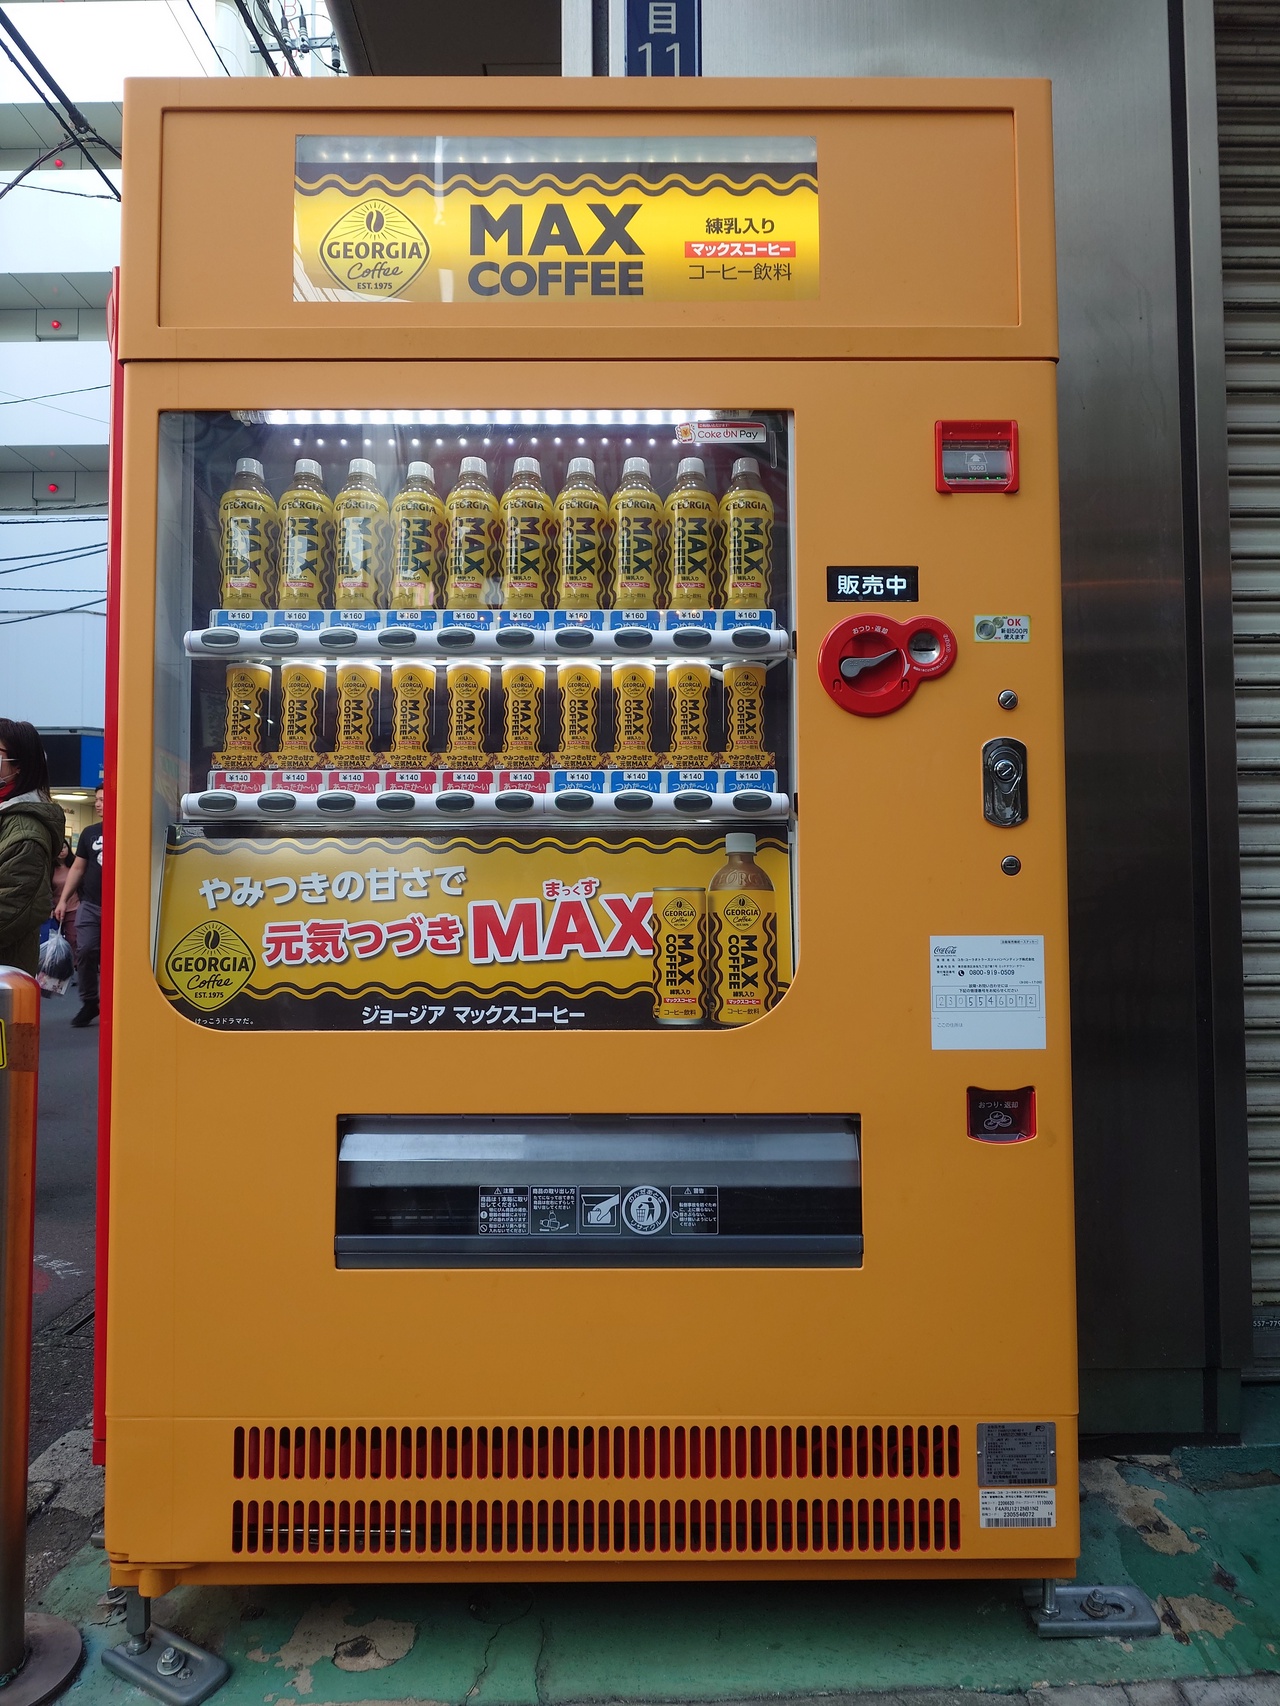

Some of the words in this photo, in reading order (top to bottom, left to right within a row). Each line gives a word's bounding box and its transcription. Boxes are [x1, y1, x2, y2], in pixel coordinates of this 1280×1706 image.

[649, 2, 677, 34] 目
[638, 42, 680, 76] 11
[469, 204, 645, 256] MAX
[705, 217, 775, 235] 練乳入り
[327, 241, 422, 259] GEORGIA
[690, 242, 791, 257] マックスコーヒー
[347, 261, 403, 281] Coffee
[468, 261, 644, 296] COFFEE
[688, 264, 792, 281] コーヒー飲料
[697, 430, 721, 439] Coke
[740, 430, 759, 440] Pay
[412, 519, 431, 577] MAX
[465, 518, 485, 576] MAX
[519, 517, 540, 575] MAX
[576, 517, 596, 575] MAX
[632, 517, 653, 575] MAX
[688, 517, 707, 575] MAX
[744, 517, 763, 575] MAX
[838, 575, 907, 595] 販売中
[1007, 618, 1021, 626] OK
[231, 700, 239, 736] COFFEE
[287, 700, 295, 736] COFFEE
[295, 700, 307, 735] MAX
[343, 700, 351, 736] COFFEE
[351, 700, 363, 735] MAX
[408, 700, 419, 735] MAX
[455, 700, 463, 736] COFFEE
[464, 700, 476, 735] MAX
[520, 700, 531, 735] MAX
[577, 700, 588, 735] MAX
[624, 700, 632, 736] COFFEE
[633, 700, 644, 735] MAX
[689, 700, 700, 735] MAX
[745, 699, 756, 734] MAX
[199, 866, 467, 910] やみつきの甘さで
[543, 877, 599, 899] まっくす
[263, 914, 463, 965] 元気つづき
[469, 894, 653, 962] MAX
[172, 956, 249, 972] GEORGIA
[665, 934, 677, 986] COFFEE
[677, 934, 694, 986] MAX
[728, 934, 740, 989] COFFEE
[741, 935, 759, 989] MAX
[187, 974, 233, 990] Coffee
[361, 1005, 446, 1025] ジョージア
[453, 1005, 585, 1025] マックスコーヒー
